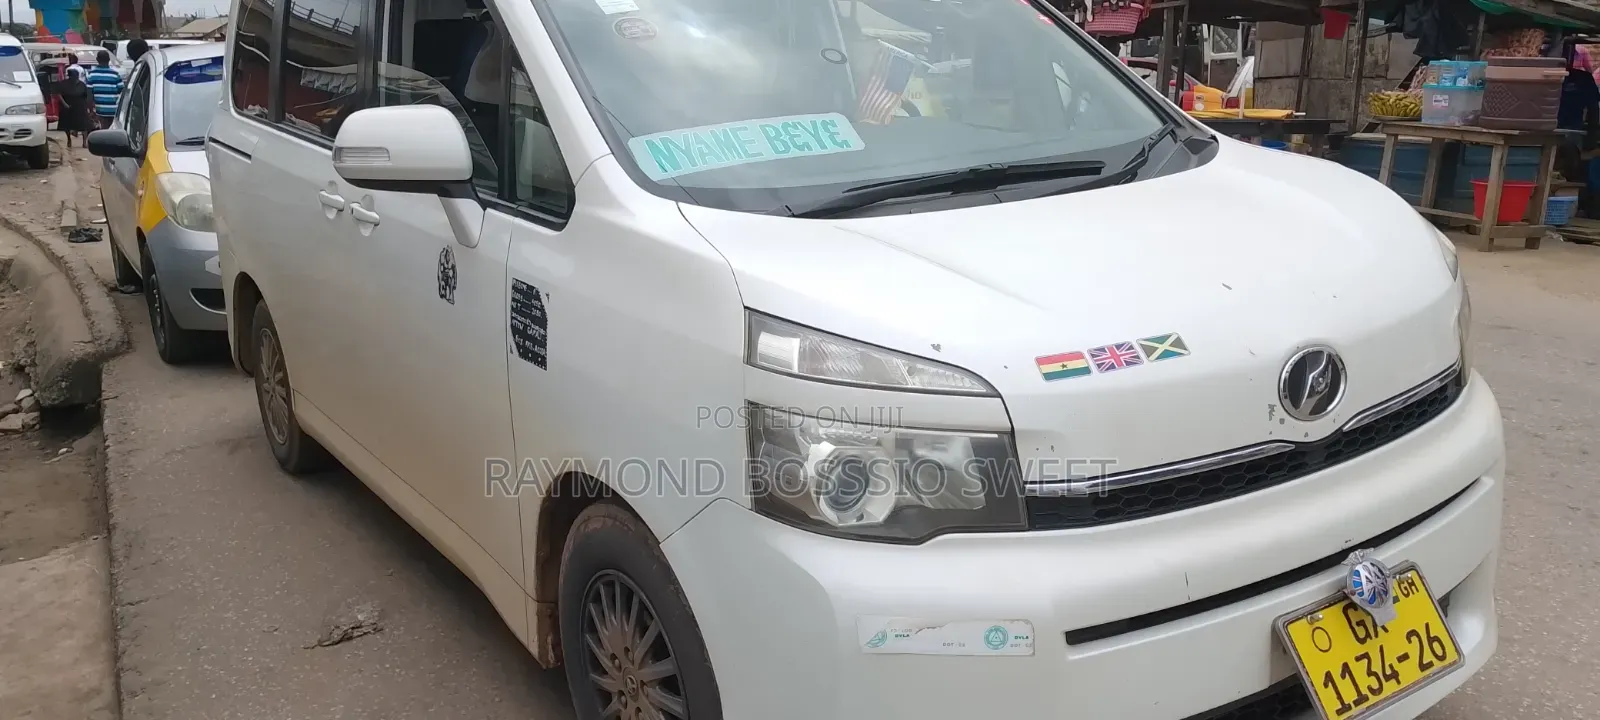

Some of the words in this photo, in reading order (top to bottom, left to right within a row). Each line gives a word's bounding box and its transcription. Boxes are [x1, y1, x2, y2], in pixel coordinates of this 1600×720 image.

[644, 125, 765, 174] NYAME
[1398, 577, 1419, 598] GH
[1323, 622, 1447, 716] 1134-26
